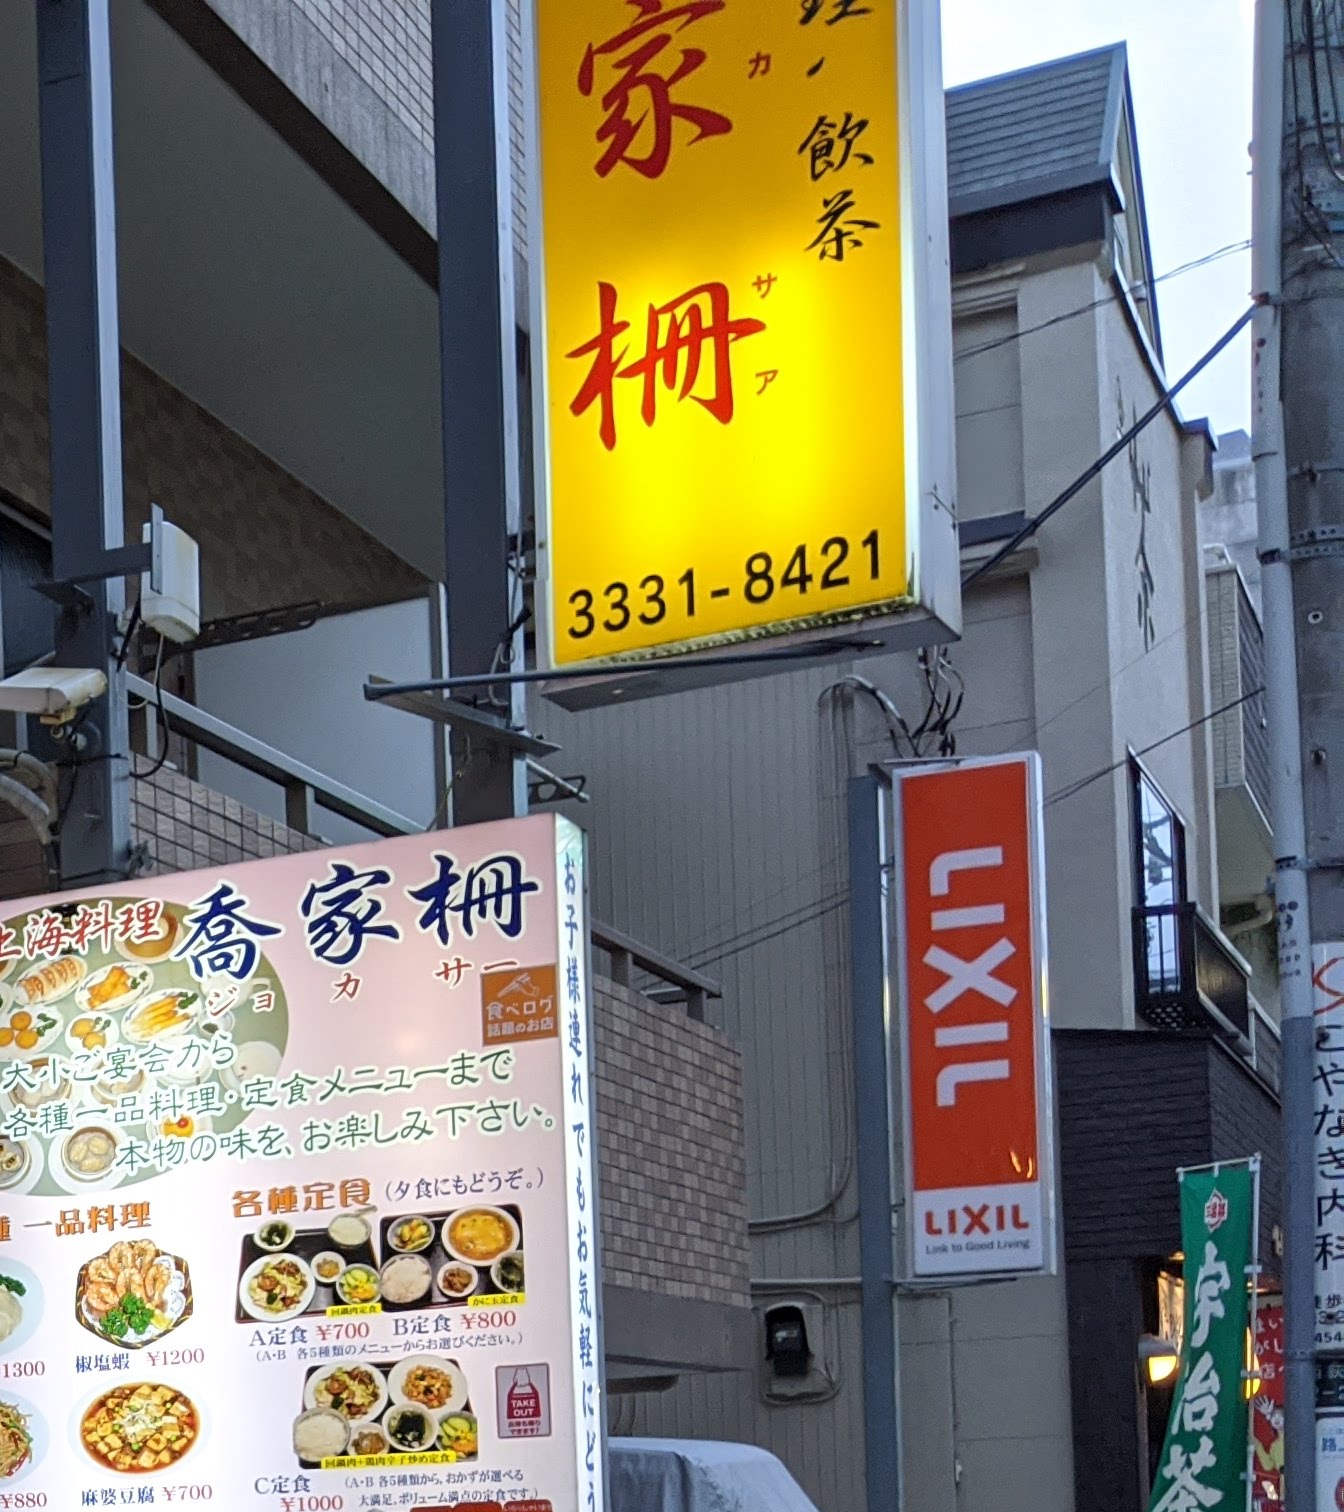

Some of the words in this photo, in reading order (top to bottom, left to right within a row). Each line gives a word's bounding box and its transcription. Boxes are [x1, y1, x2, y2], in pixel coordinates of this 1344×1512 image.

[568, 530, 882, 639] 3331-8421
[922, 846, 1017, 1106] LIXIL
[487, 998, 554, 1020] 食べログ
[4, 1037, 234, 1091] 大小ご宴会から
[6, 1050, 512, 1139] 各種一品料理・定食メニューまで
[117, 1100, 556, 1172] 本物の味を、お楽しみ下さい。
[232, 1178, 371, 1217] 各種定食
[23, 1201, 151, 1236] 一品料理
[925, 1203, 1030, 1236] LIXIL
[965, 1240, 994, 1251] Good
[997, 1239, 1030, 1250] Living
[250, 1325, 308, 1347] A定食
[315, 1322, 370, 1340] ¥700
[392, 1314, 452, 1336] B定食
[460, 1310, 517, 1329] ¥800
[146, 1348, 204, 1367] ¥1200
[511, 1398, 536, 1409] TAKE
[513, 1407, 534, 1417] OUT
[81, 1486, 155, 1507] 麻婆豆腐
[161, 1484, 213, 1501] ¥700
[254, 1475, 311, 1495] C定食
[280, 1496, 343, 1512] ¥1000
